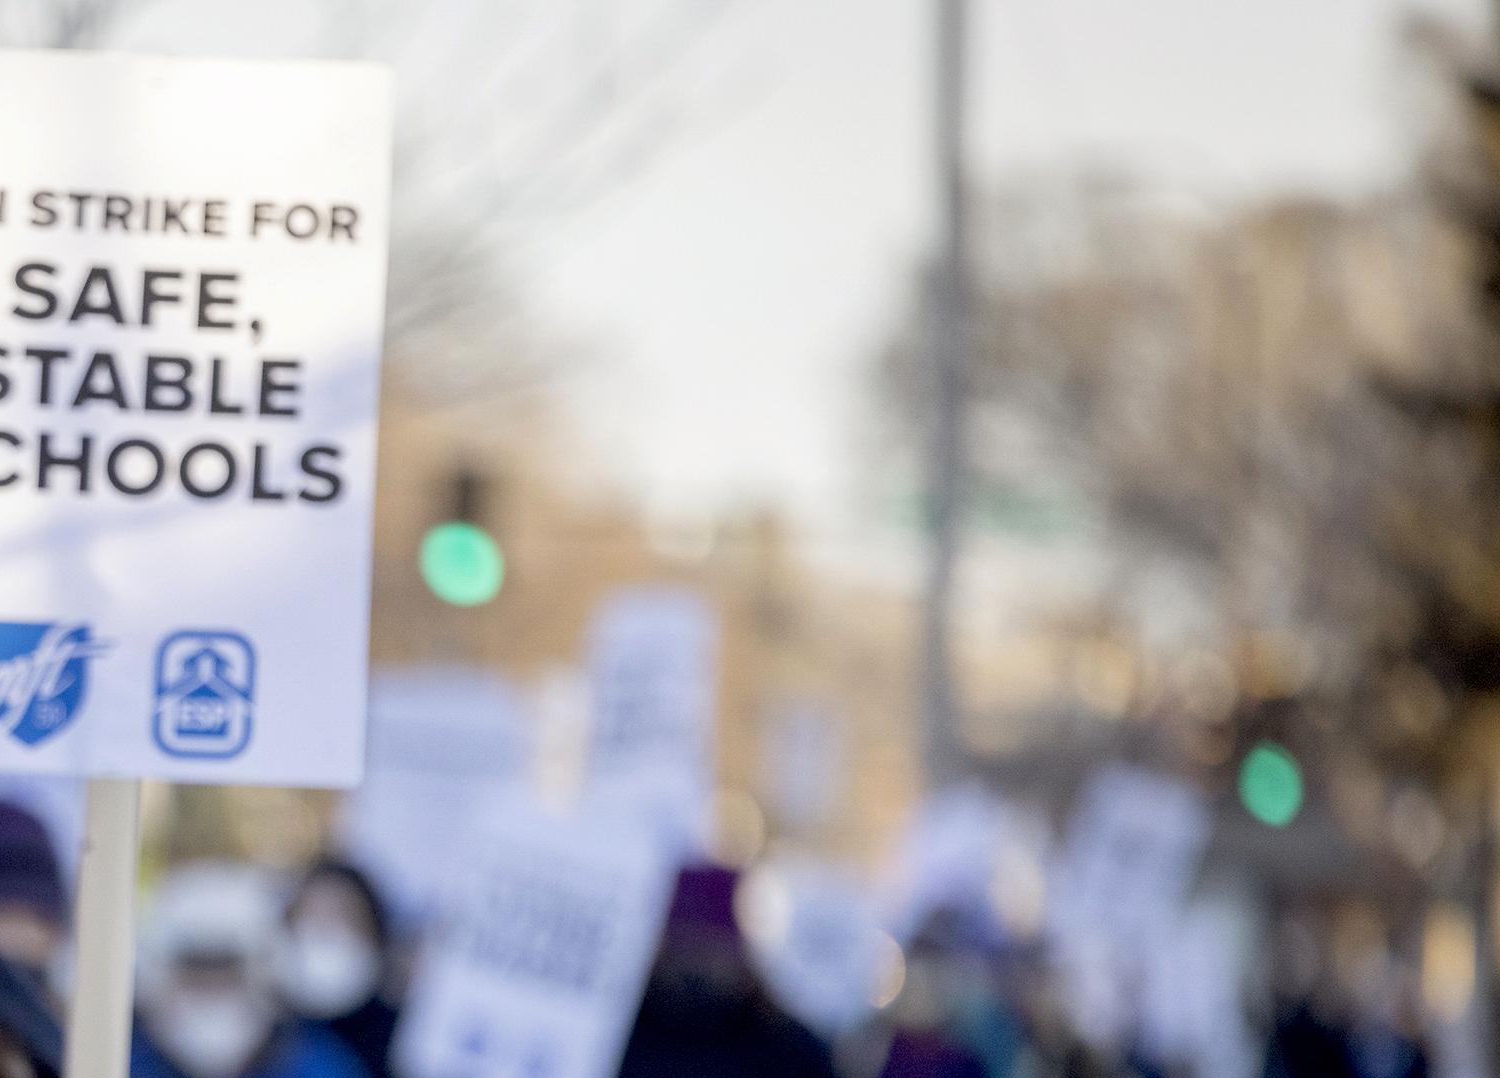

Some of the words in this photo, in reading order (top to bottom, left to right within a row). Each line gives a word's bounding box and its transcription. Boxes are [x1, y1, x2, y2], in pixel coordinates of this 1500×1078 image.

[31, 191, 227, 236] STRIKE
[249, 202, 359, 242] FOR
[11, 262, 267, 346] SAFE,
